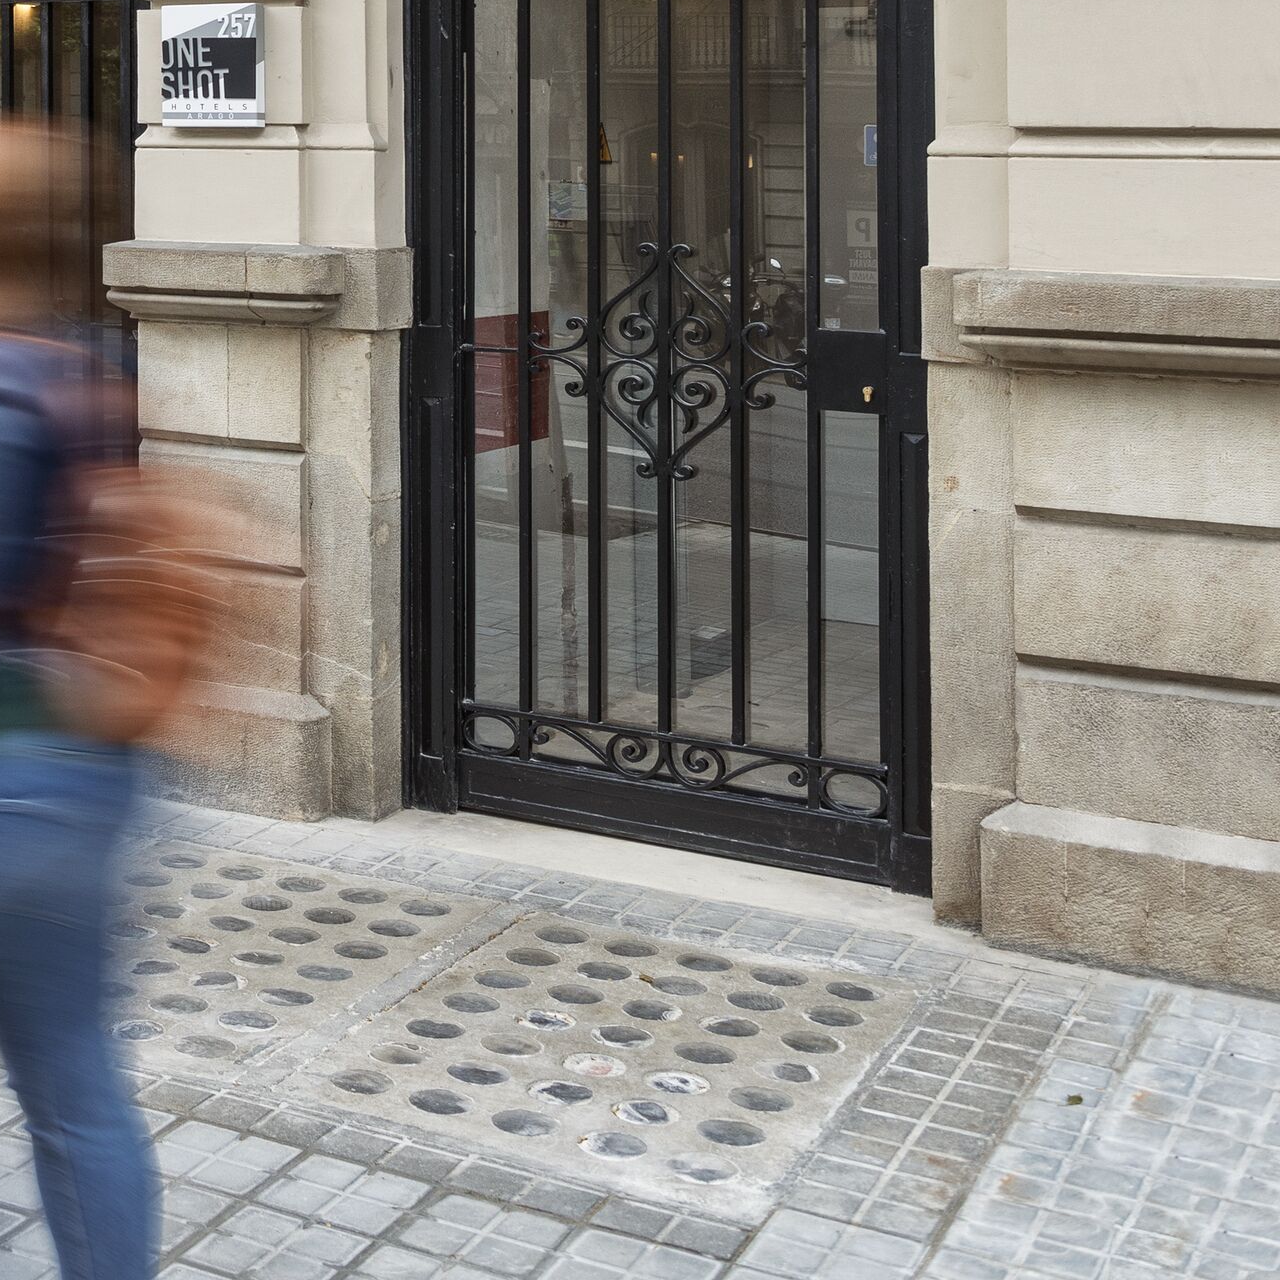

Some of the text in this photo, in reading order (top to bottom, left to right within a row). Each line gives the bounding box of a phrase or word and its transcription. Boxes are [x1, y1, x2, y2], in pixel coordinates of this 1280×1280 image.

[217, 13, 256, 38] 257
[162, 37, 213, 70] ONE
[161, 68, 230, 101] SHOT
[171, 103, 248, 111] HOTELS
